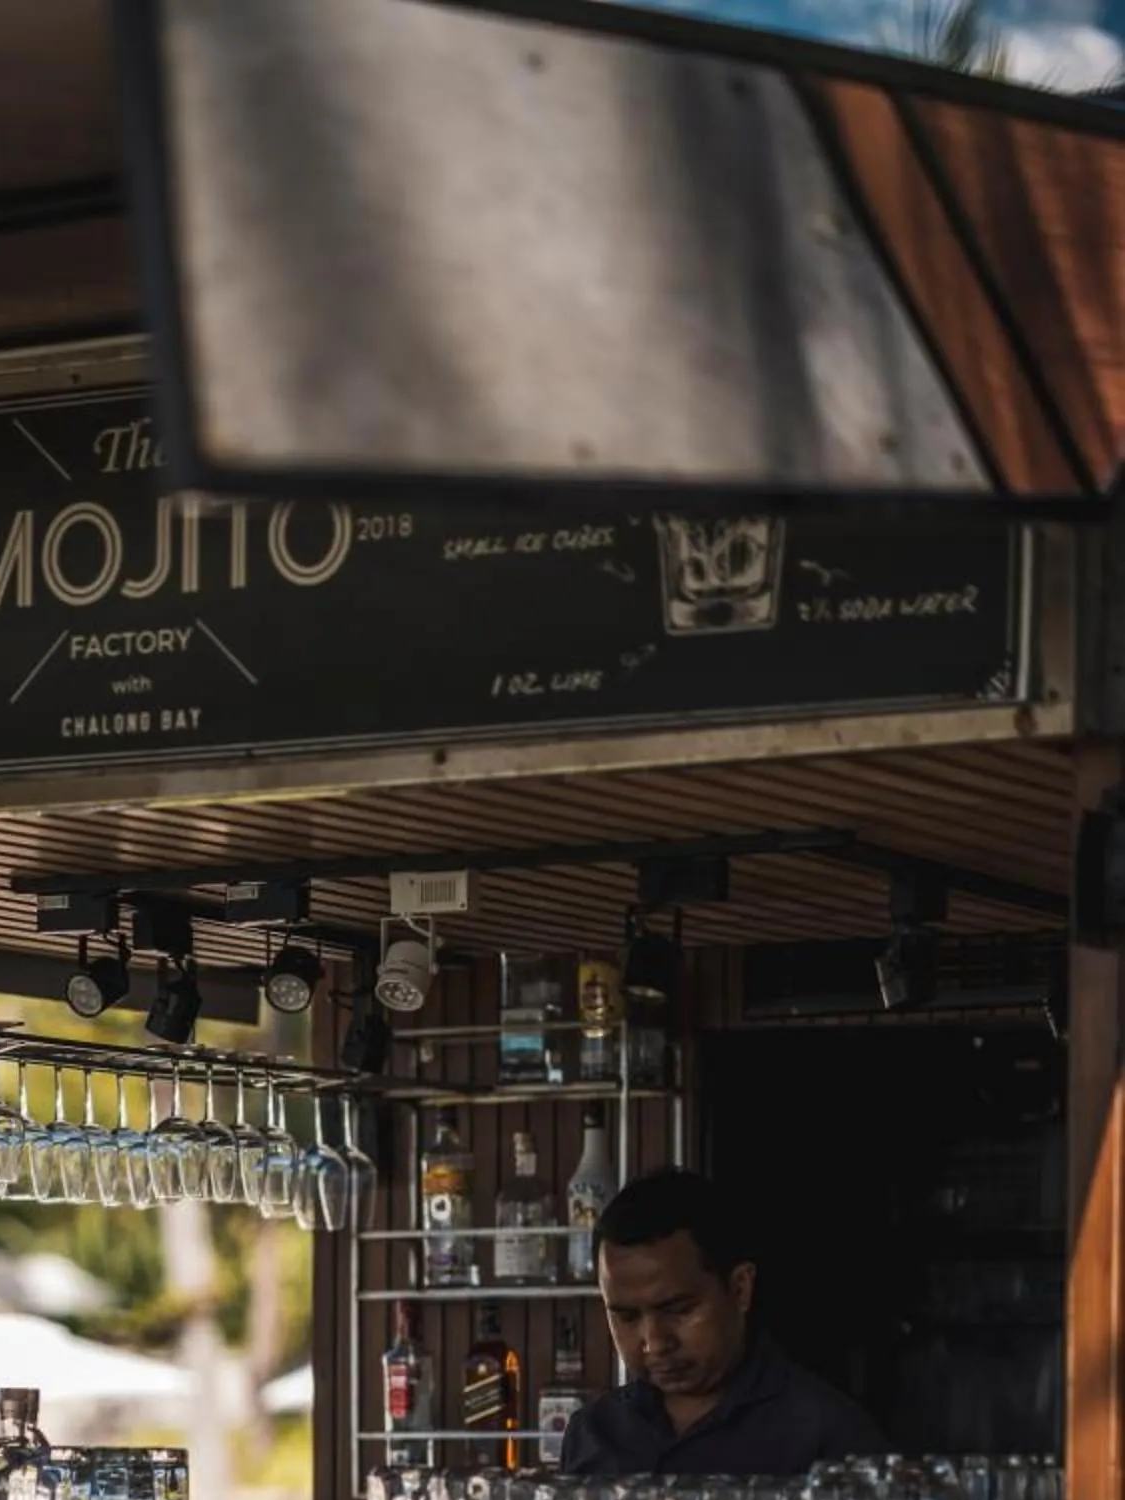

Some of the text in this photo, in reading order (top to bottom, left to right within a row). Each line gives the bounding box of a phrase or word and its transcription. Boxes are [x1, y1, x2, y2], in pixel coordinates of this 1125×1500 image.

[358, 513, 412, 542] 2018
[70, 628, 193, 659] FACTORY
[111, 673, 152, 695] with
[61, 708, 202, 738] CHALONG BAY
